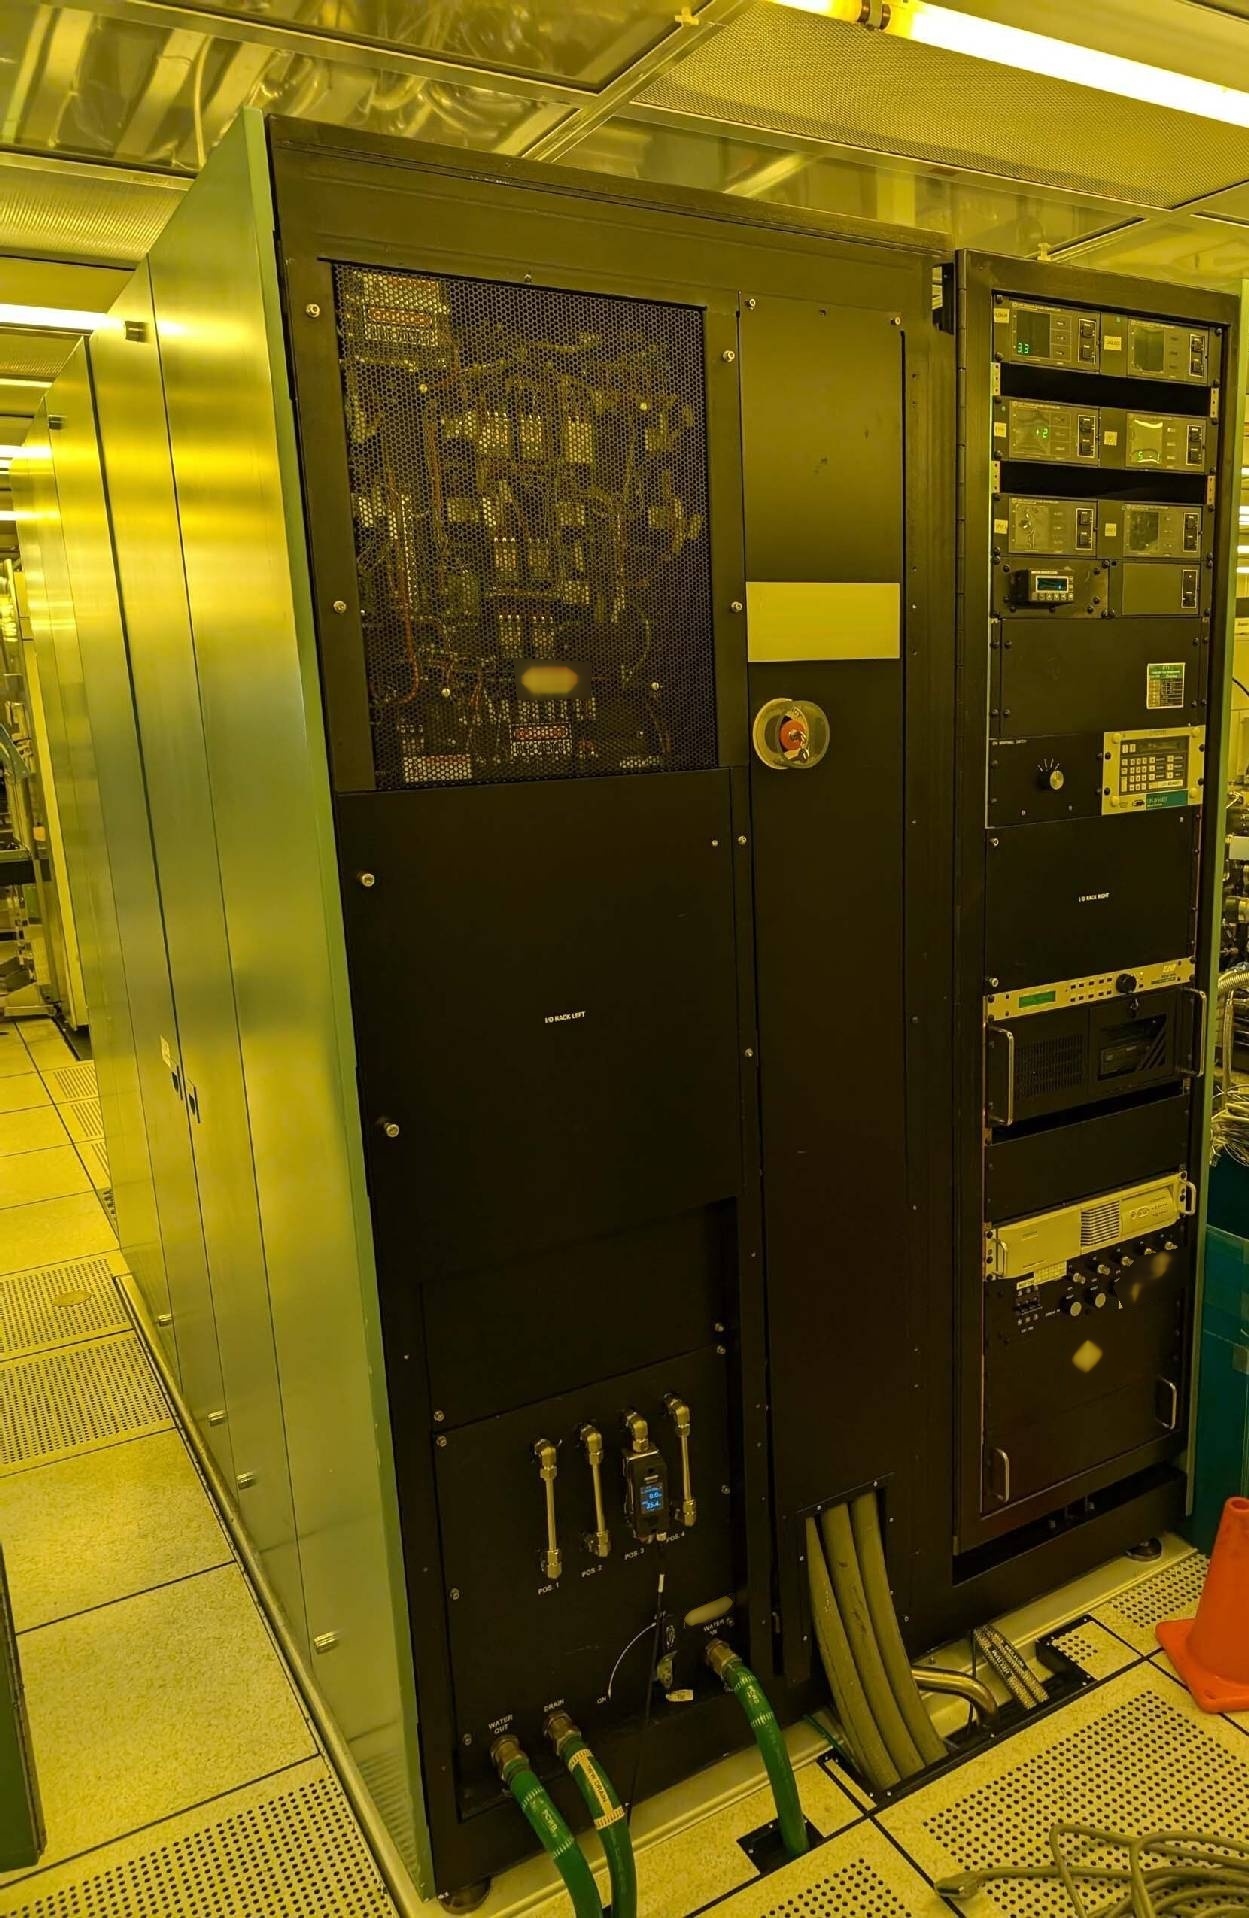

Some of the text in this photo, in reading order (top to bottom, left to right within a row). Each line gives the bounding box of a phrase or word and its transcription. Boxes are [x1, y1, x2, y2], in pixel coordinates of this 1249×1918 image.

[554, 1014, 571, 1022] RACK
[543, 1698, 565, 1713] DRAIN
[488, 1714, 513, 1730] WATER
[494, 1723, 508, 1734] OUT
